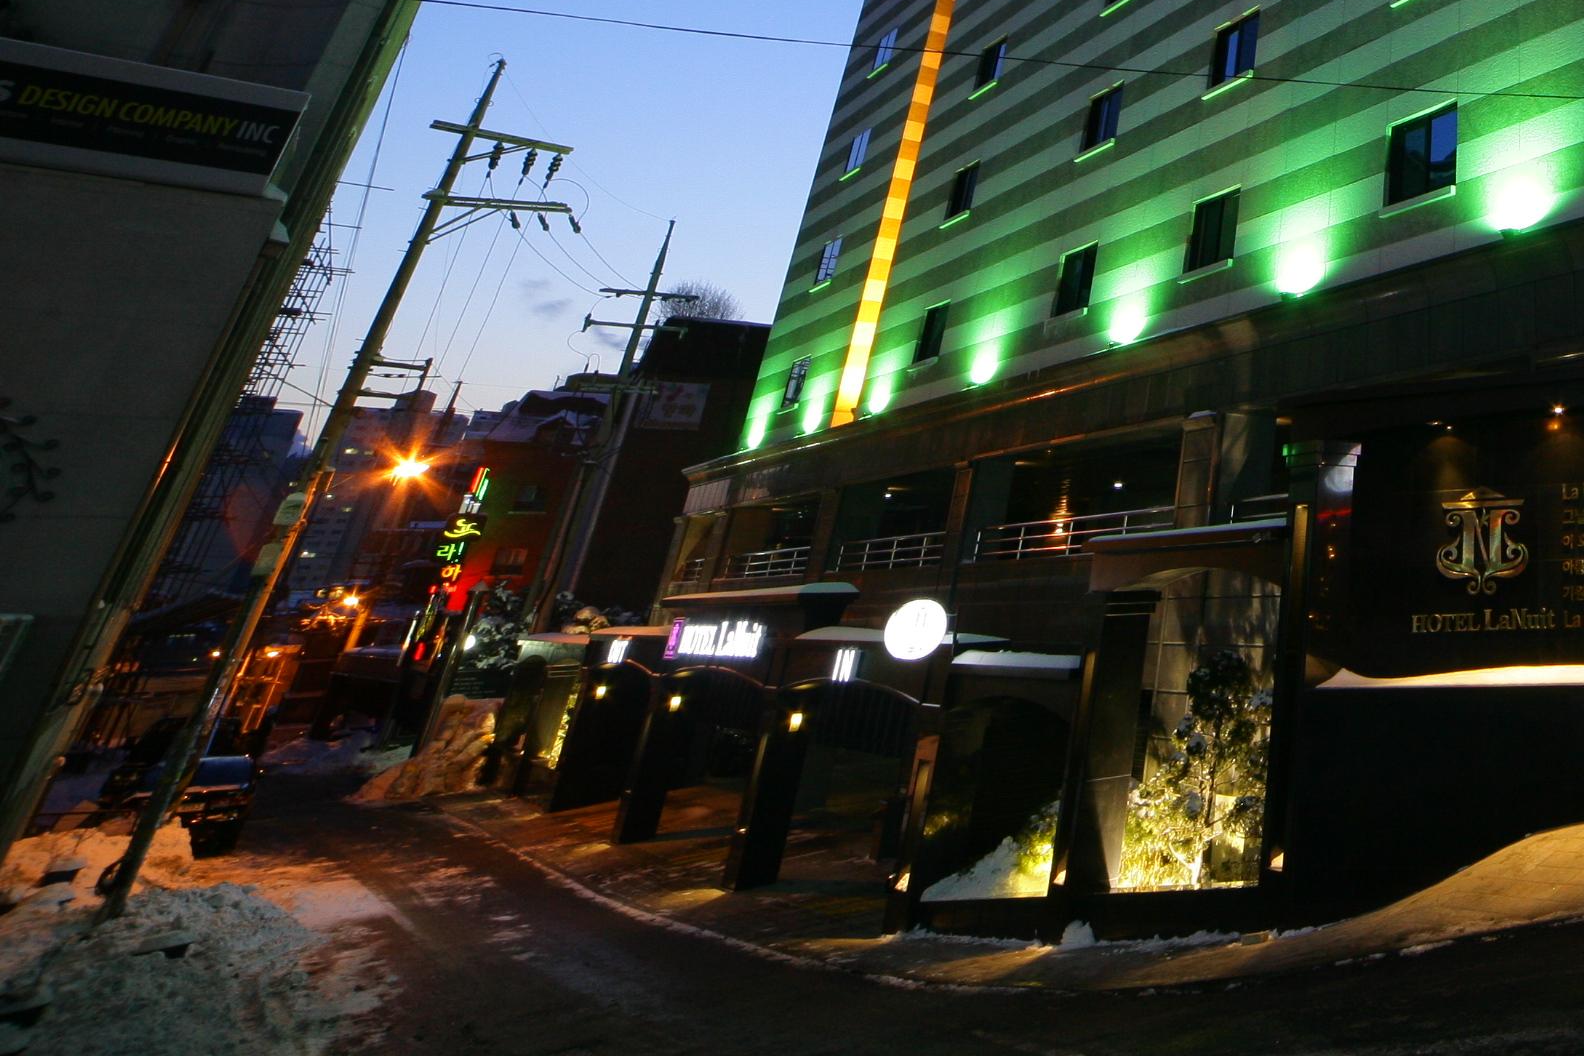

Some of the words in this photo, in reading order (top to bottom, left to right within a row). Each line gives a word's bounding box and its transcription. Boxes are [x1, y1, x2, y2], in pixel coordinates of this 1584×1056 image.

[16, 84, 120, 118] DESIGN
[119, 101, 239, 137] COMPANY
[235, 119, 281, 144] INC
[1562, 483, 1579, 501] La
[1411, 614, 1480, 634] HOTEL
[1483, 607, 1557, 632] LaNuit
[832, 648, 856, 682] IN
